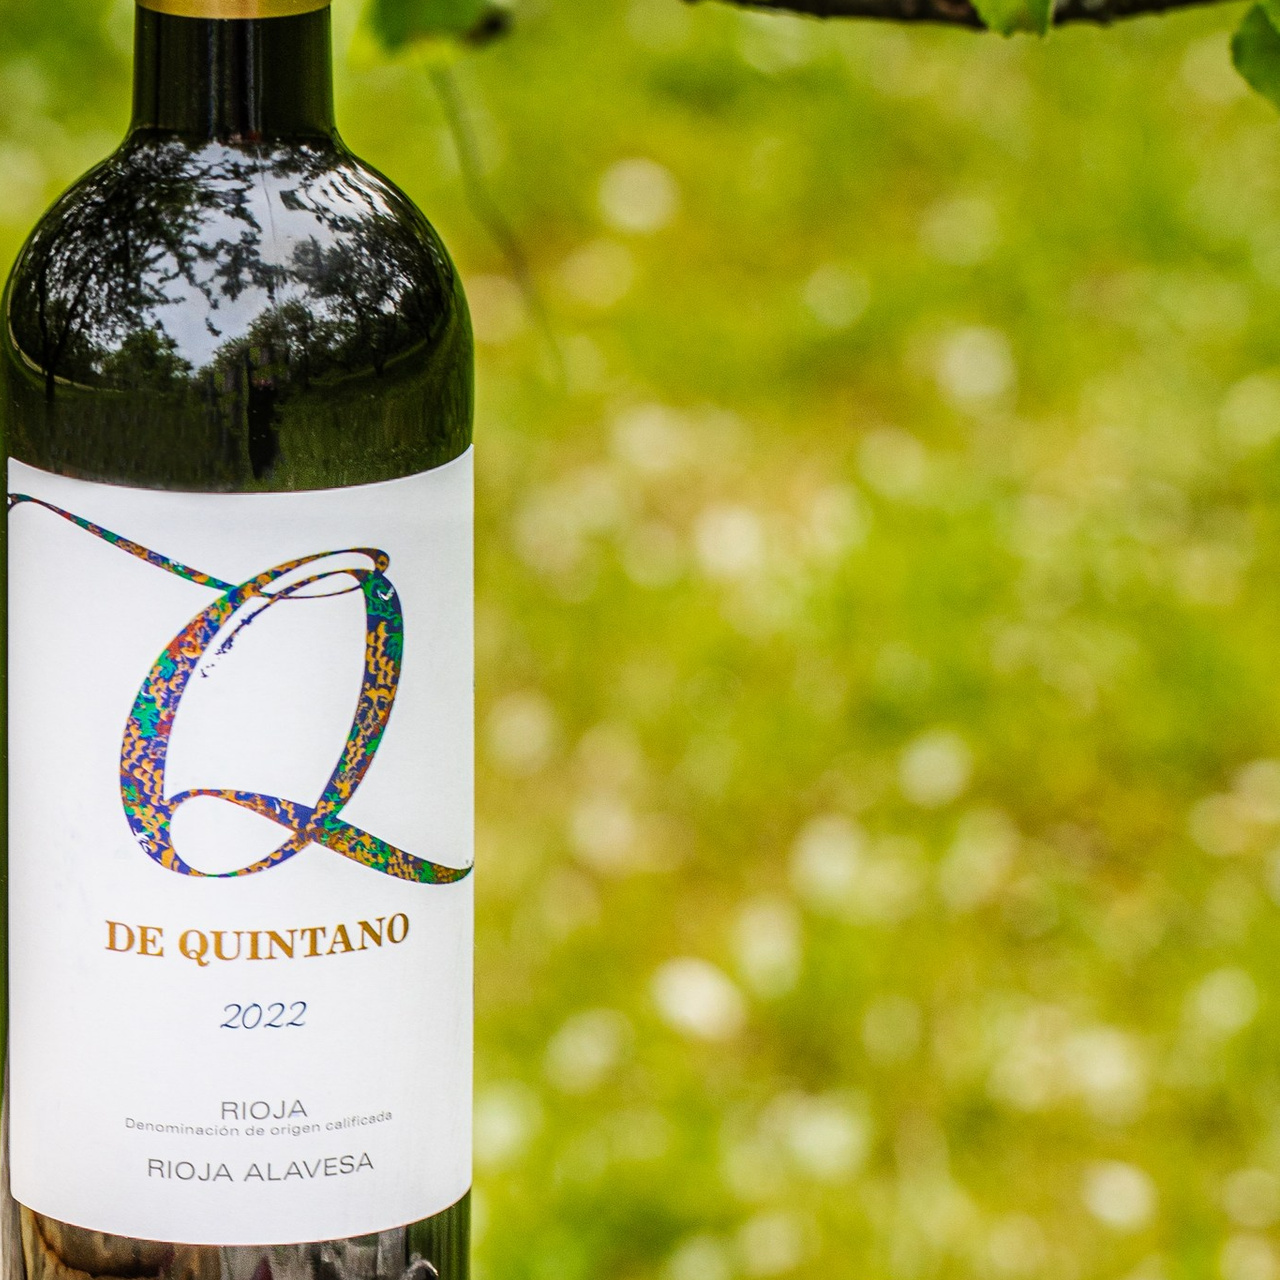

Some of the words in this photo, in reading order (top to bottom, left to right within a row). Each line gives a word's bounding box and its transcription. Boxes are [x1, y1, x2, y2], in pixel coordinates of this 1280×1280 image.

[7, 493, 474, 885] Q
[104, 919, 165, 957] DE
[178, 912, 410, 967] QUINTANO
[220, 1001, 307, 1030] 2022
[125, 1117, 240, 1137] Denominación
[245, 1125, 265, 1137] de
[270, 1123, 321, 1137] origen
[325, 1110, 393, 1131] calificada
[220, 1099, 308, 1120] RIOJA
[147, 1158, 234, 1182] RIOJA
[243, 1152, 374, 1182] ALAVESA
